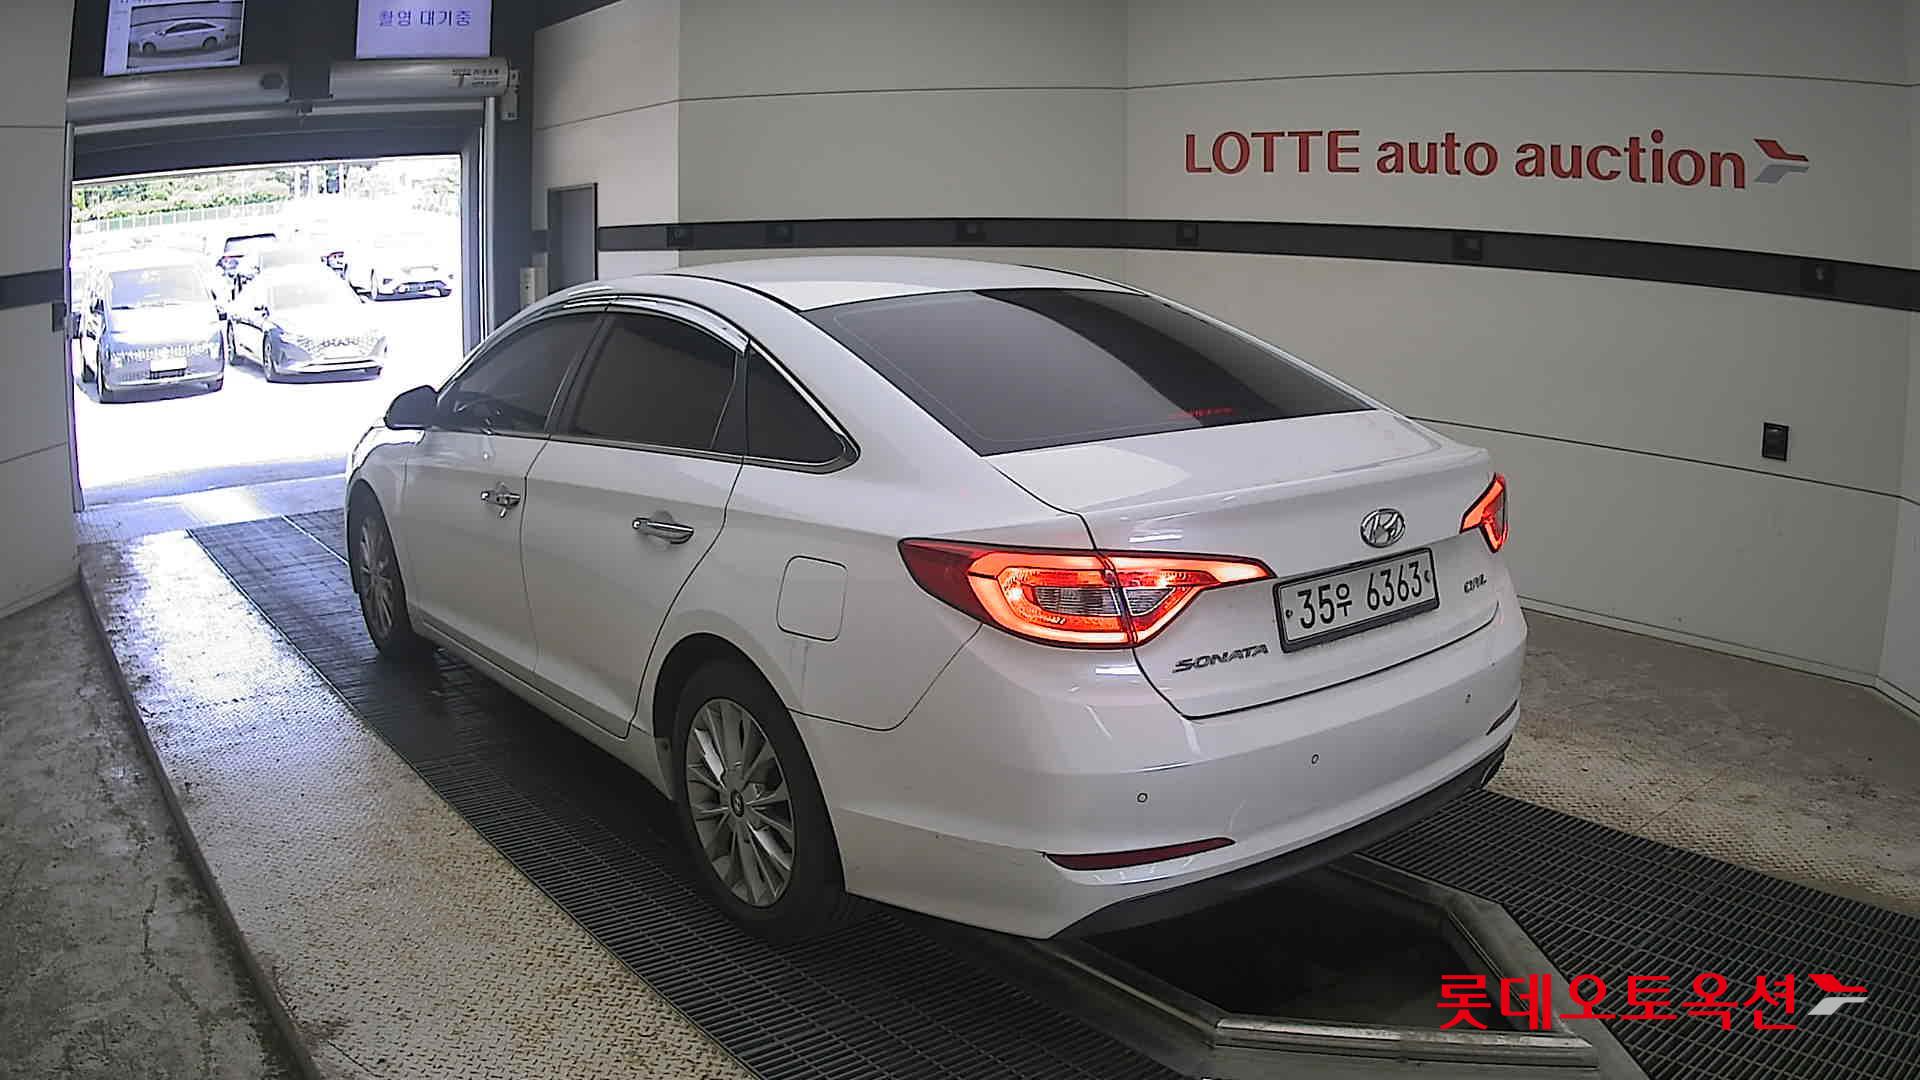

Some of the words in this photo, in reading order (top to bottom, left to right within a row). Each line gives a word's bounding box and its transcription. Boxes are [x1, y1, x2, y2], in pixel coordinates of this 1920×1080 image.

[420, 10, 471, 27] 대기중
[1185, 130, 1361, 174] LOTTE
[1376, 132, 1499, 176] auto
[1514, 128, 1746, 189] auction
[1297, 583, 1353, 629] 35우
[1366, 560, 1422, 611] 6363
[1172, 643, 1269, 674] SONATA
